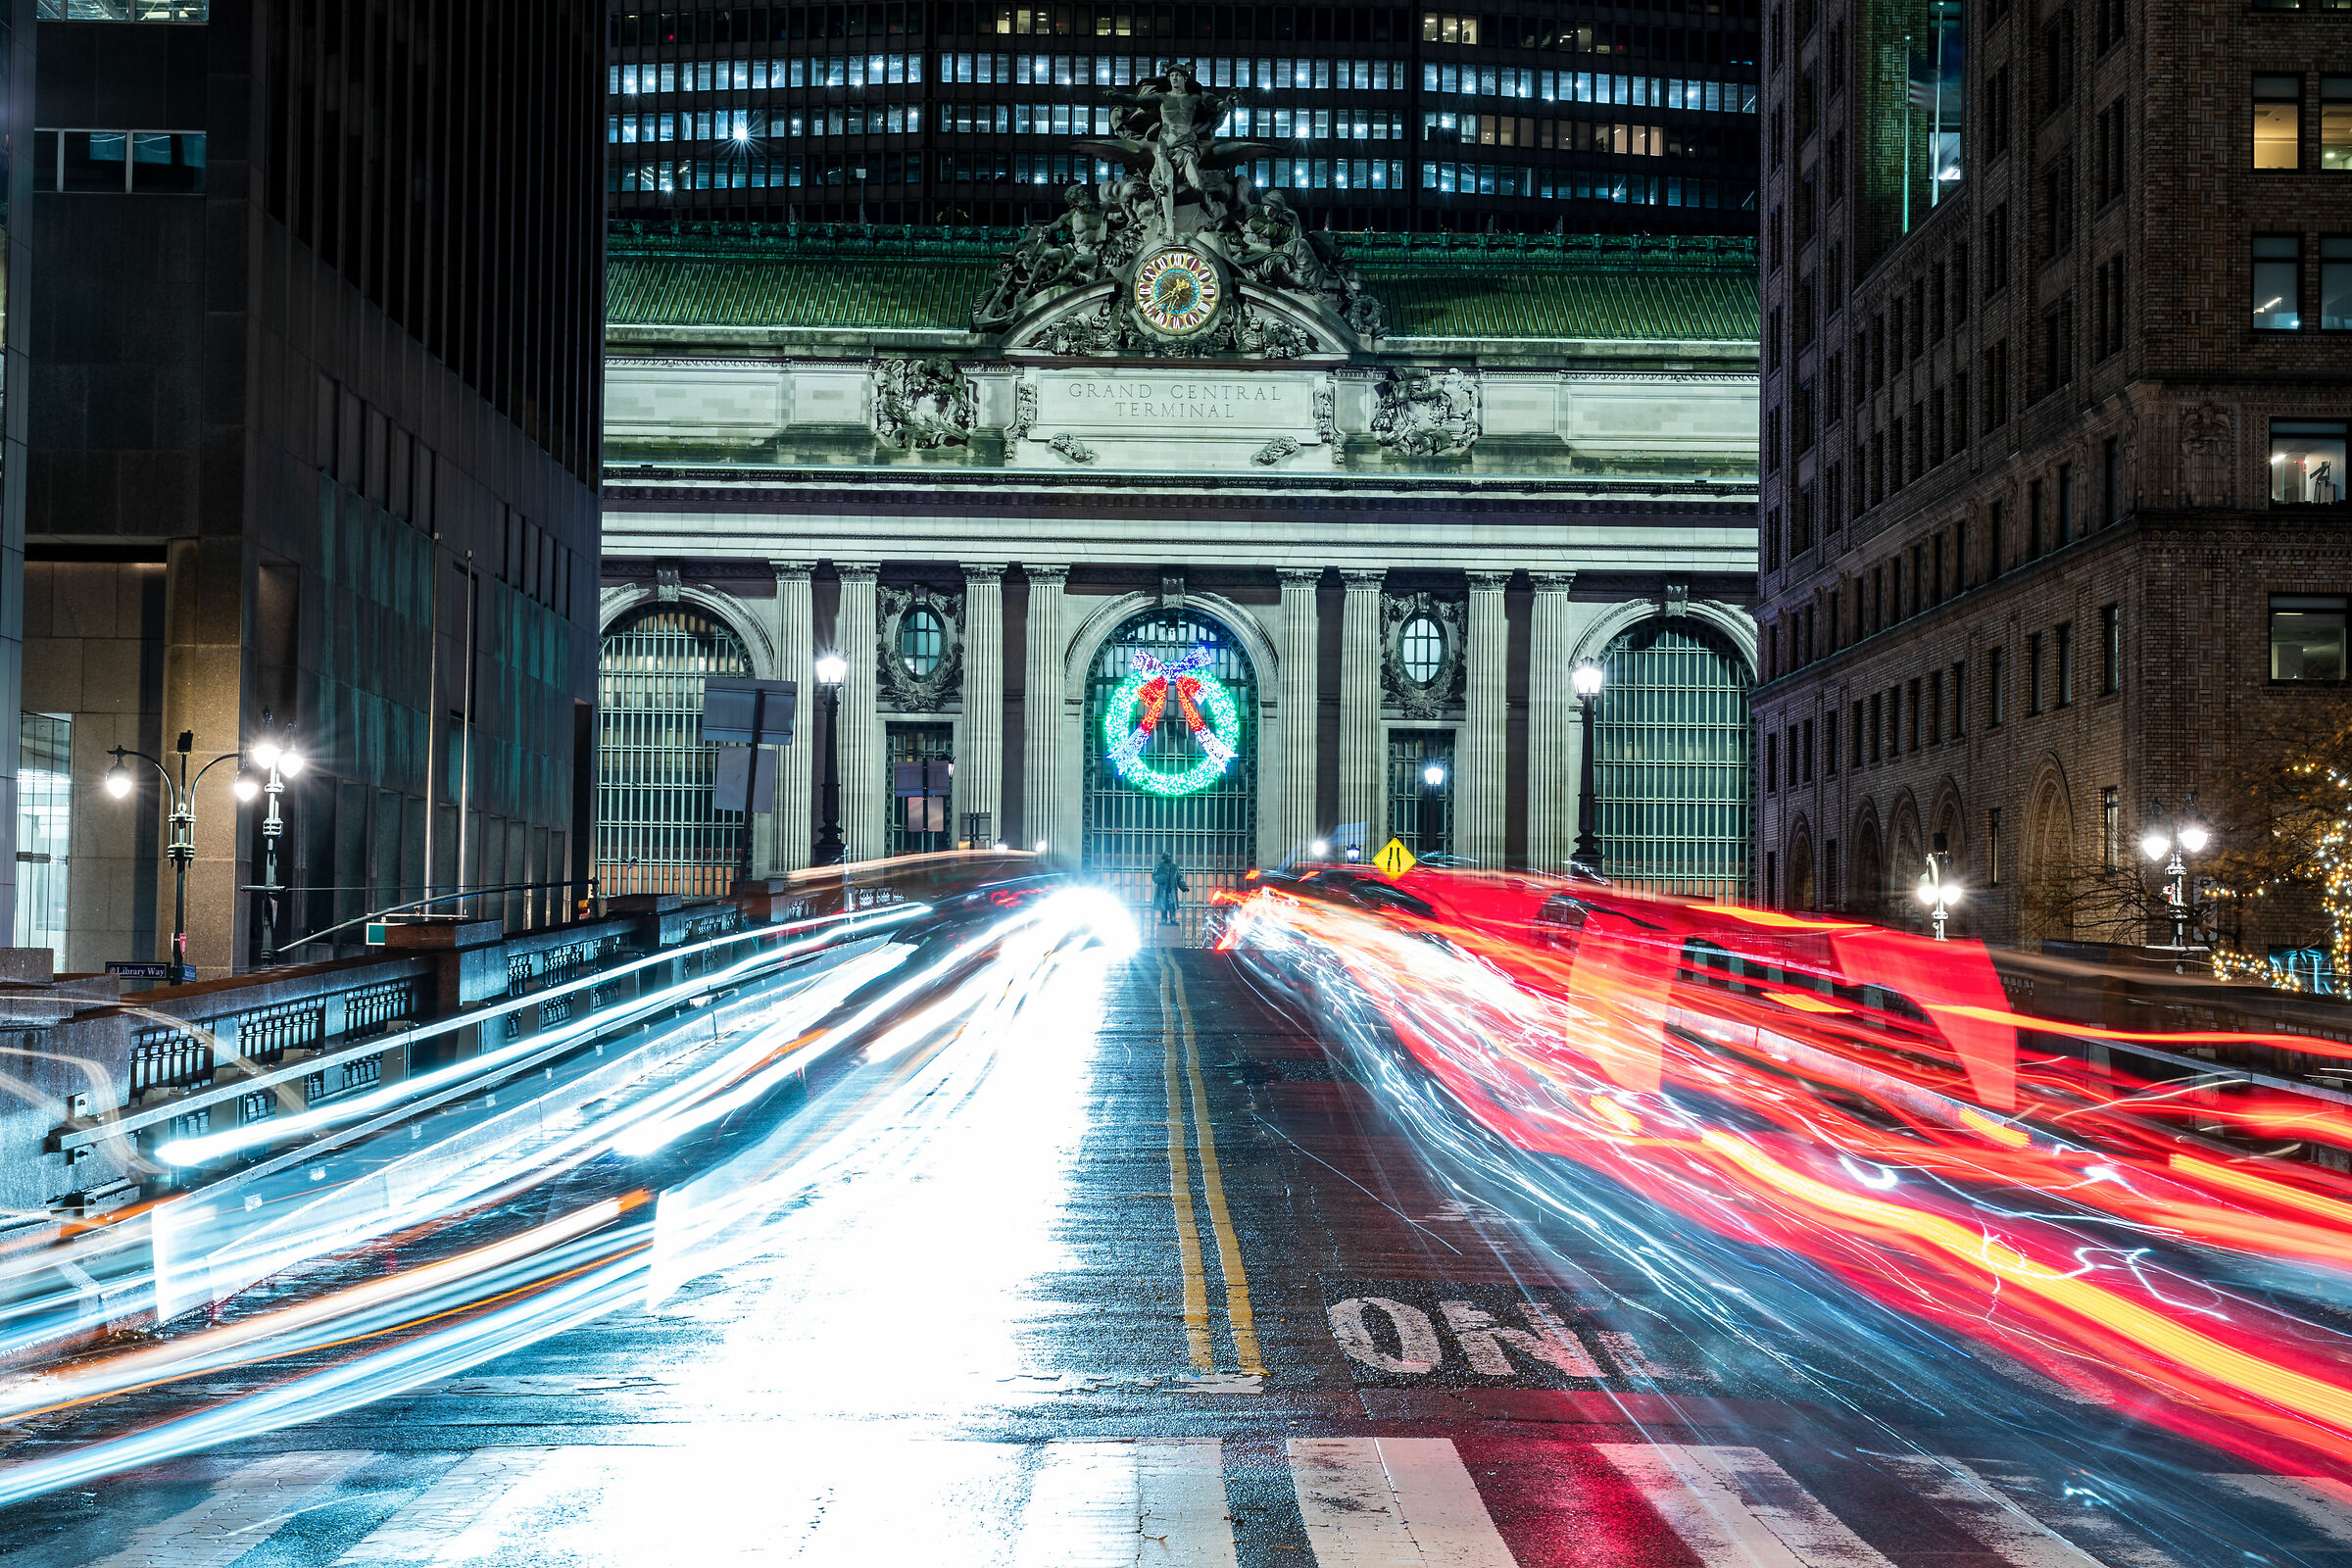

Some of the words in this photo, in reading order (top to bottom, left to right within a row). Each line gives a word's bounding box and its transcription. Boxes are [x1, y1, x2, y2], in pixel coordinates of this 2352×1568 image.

[1198, 270, 1211, 281] II
[1068, 383, 1152, 398] GRAND
[1170, 385, 1282, 400] CENTRAL
[1115, 402, 1235, 417] TERMINAL
[117, 967, 146, 977] Library
[147, 967, 165, 977] Way
